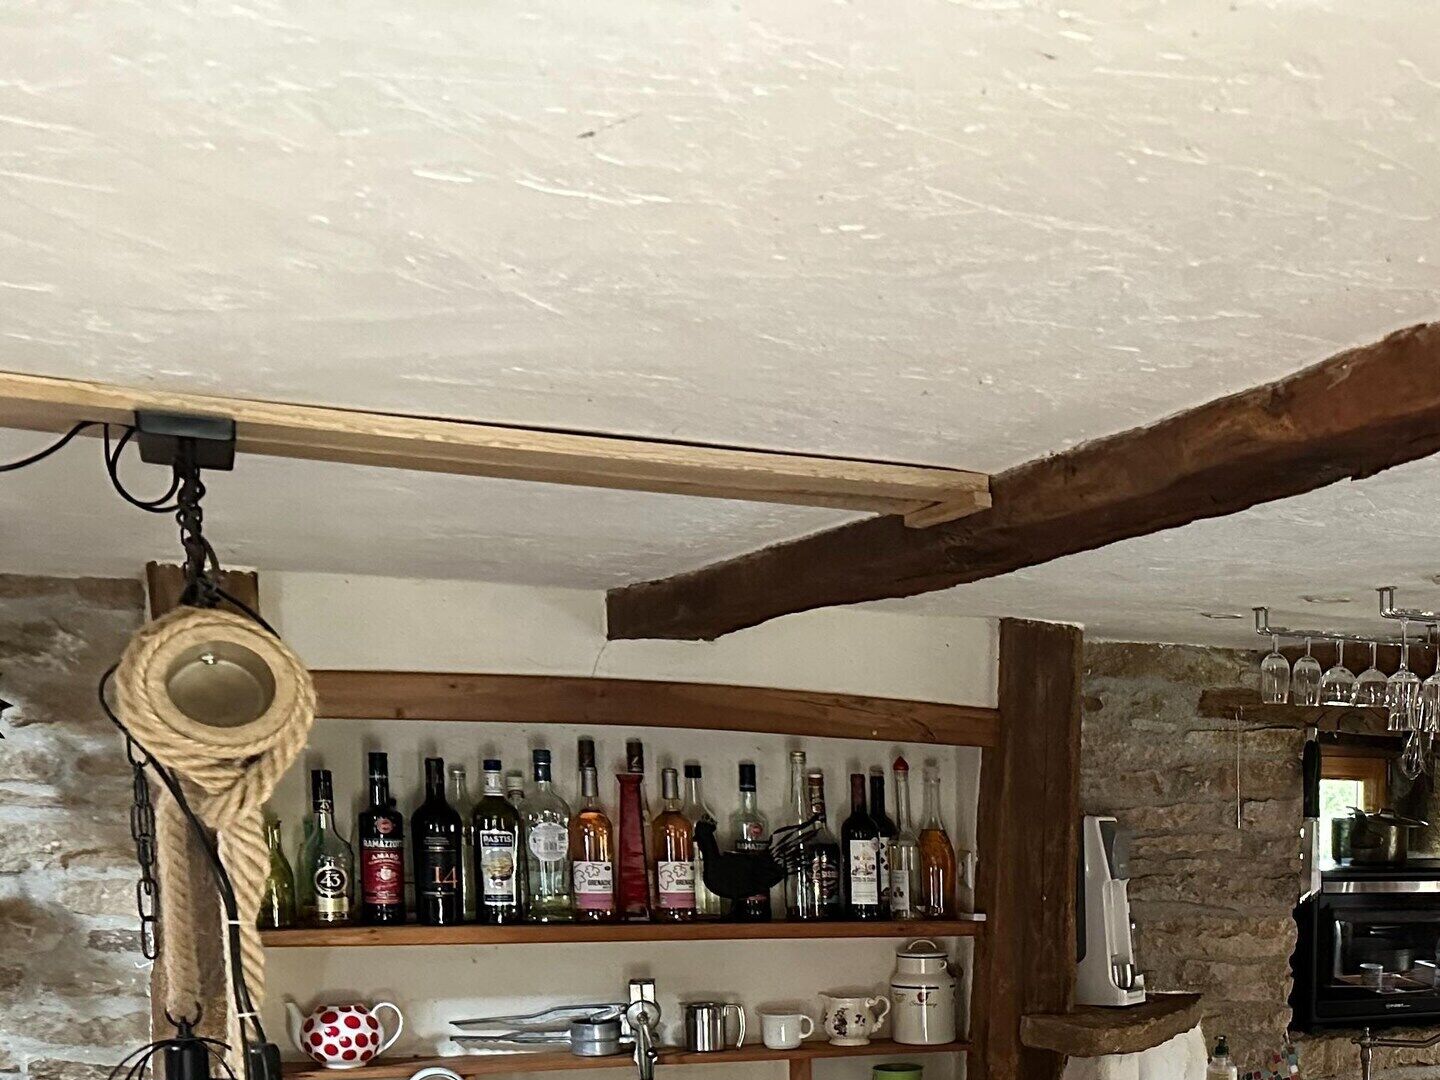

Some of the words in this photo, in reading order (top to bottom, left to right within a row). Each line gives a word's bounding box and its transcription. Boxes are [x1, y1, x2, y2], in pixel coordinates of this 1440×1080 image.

[483, 835, 512, 843] PASTIS
[371, 852, 399, 860] AMARO
[320, 870, 341, 887] 43
[432, 866, 458, 889] 14
